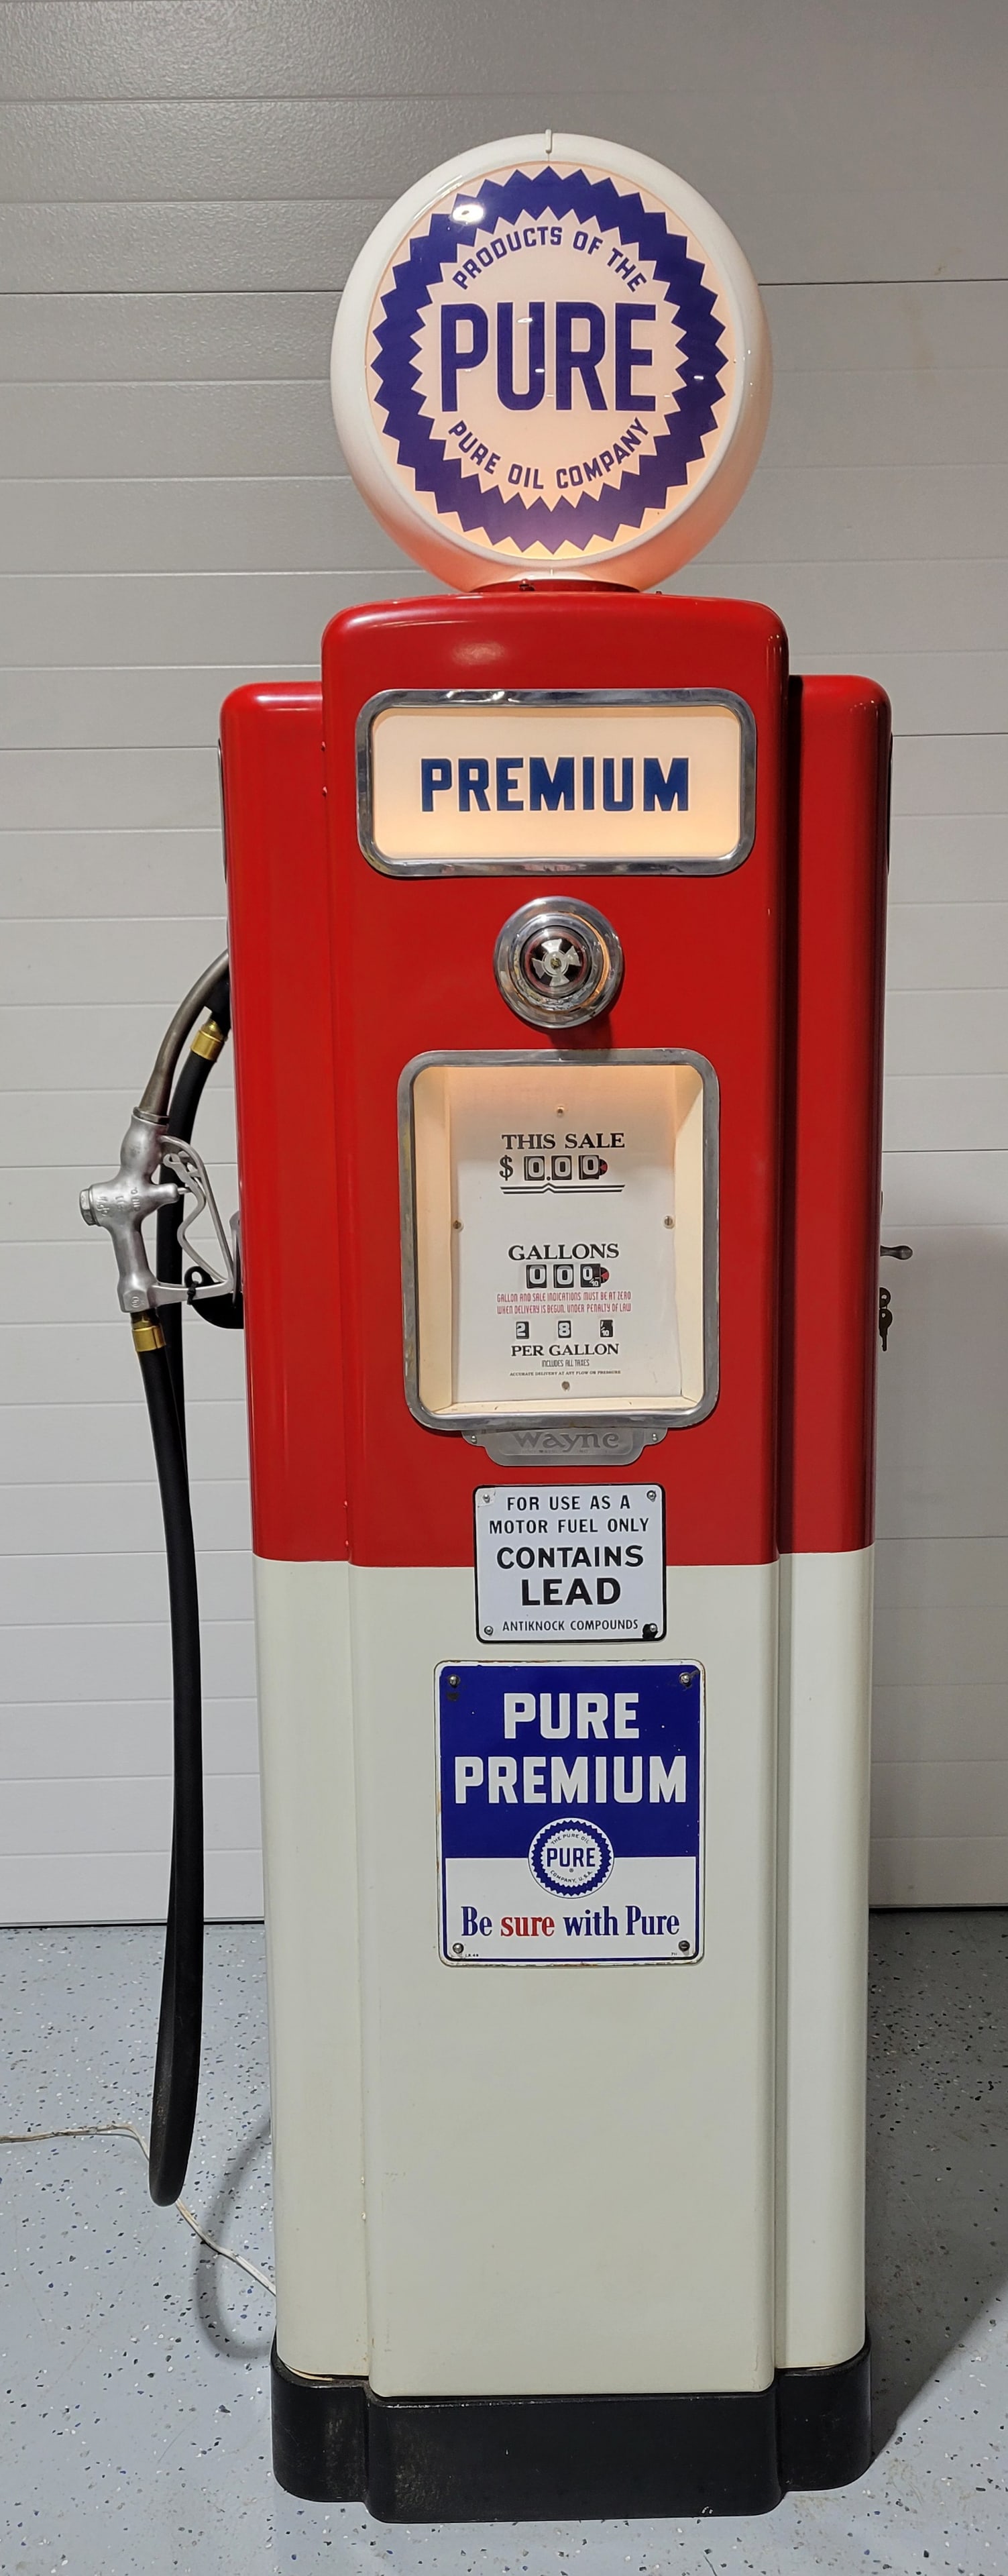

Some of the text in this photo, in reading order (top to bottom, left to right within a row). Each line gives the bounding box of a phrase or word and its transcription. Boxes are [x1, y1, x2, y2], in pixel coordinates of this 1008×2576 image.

[451, 226, 647, 292] PRODUCTS OF THE
[440, 301, 657, 412] PURE
[448, 417, 649, 489] PURE OIL COMPANY
[421, 756, 689, 812] PREMIUM
[502, 1132, 625, 1149] THIS SALE
[508, 1243, 619, 1260] GALLONS
[497, 1291, 631, 1302] GALLON AND SALE INDICATIONS MUST BE AT ZERO
[497, 1305, 512, 1314] WHEN
[514, 1305, 540, 1314] DELIVERY
[541, 1305, 546, 1313] IS
[567, 1304, 584, 1313] UNDER
[586, 1303, 610, 1313] PENALTY
[612, 1303, 618, 1312] OF
[620, 1303, 631, 1312] LAW
[559, 1322, 570, 1336] 8
[511, 1344, 619, 1356] PER GALLON
[513, 1431, 620, 1452] Wayne
[507, 1495, 630, 1511] FOR USE AS A
[490, 1517, 649, 1534] MOTOR FUEL ONLY
[496, 1545, 644, 1569] CONTAINS
[521, 1577, 621, 1606] LEAD
[502, 1619, 638, 1631] ANTIKNOCK COMPOUNDS
[504, 1693, 639, 1739] PURE
[455, 1756, 687, 1804] PREMIUM
[551, 1836, 561, 1845] THE
[581, 1836, 590, 1844] OIL
[547, 1847, 596, 1867] PURE
[460, 1905, 679, 1937] Be sure with Pure
